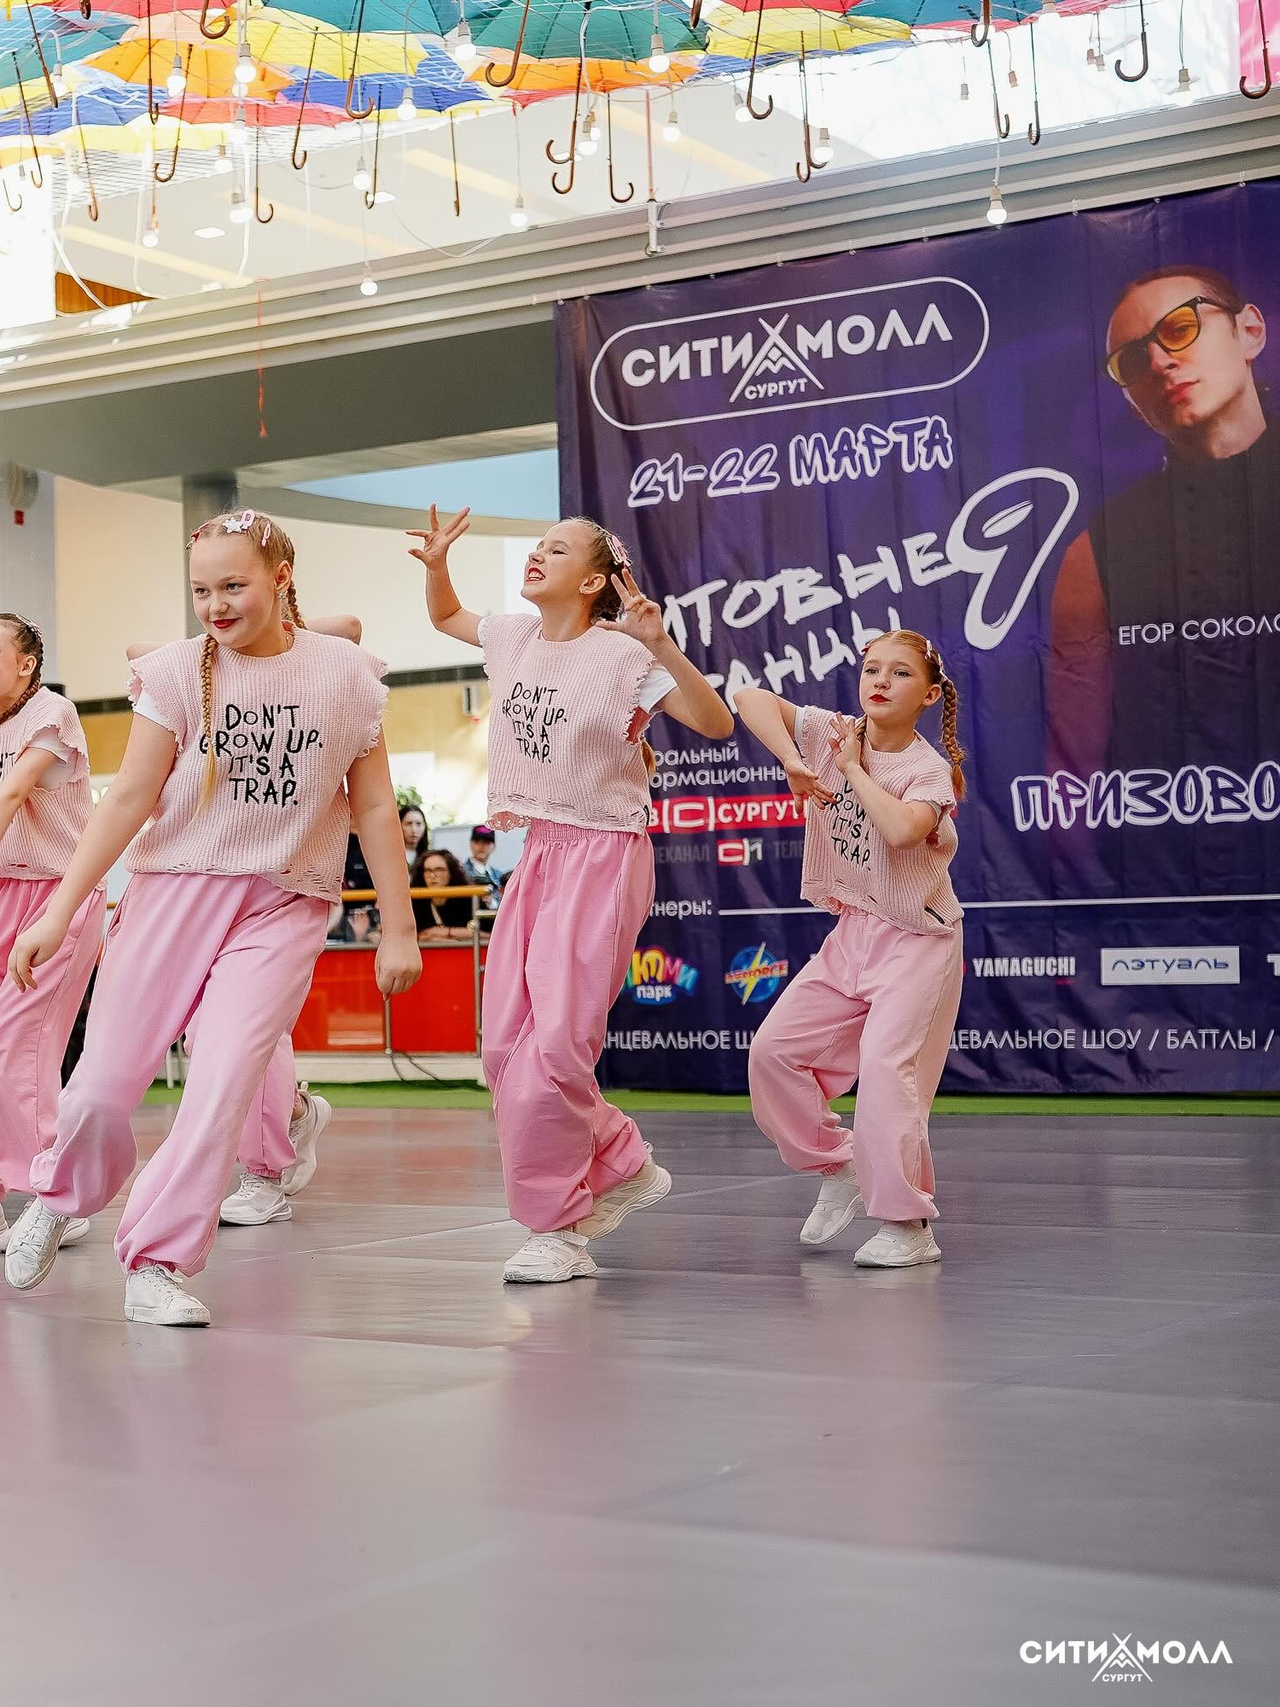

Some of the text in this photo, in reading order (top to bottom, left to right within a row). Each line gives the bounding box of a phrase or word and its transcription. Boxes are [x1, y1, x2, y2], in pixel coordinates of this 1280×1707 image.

[744, 377, 808, 400] СУРГУТ
[627, 415, 954, 507] 21-22 МАРТА
[1118, 622, 1175, 645] ЕГОР
[511, 682, 558, 706] DON'T
[226, 703, 300, 730] DON'T
[543, 707, 568, 726] UP.
[286, 729, 323, 753] UP.
[540, 724, 550, 744] A
[516, 738, 552, 764] TRAP.
[229, 752, 295, 778] IT'S A
[229, 778, 299, 808] TRAP.
[833, 815, 862, 839] IT'S
[831, 836, 872, 872] TRAP.
[972, 956, 1076, 978] YAMAGUCHI
[604, 1029, 731, 1051] НЦЕВАЛЬНОЕ
[1082, 1028, 1142, 1050] ШОУ
[1166, 1028, 1256, 1050] БАТТЛЫ
